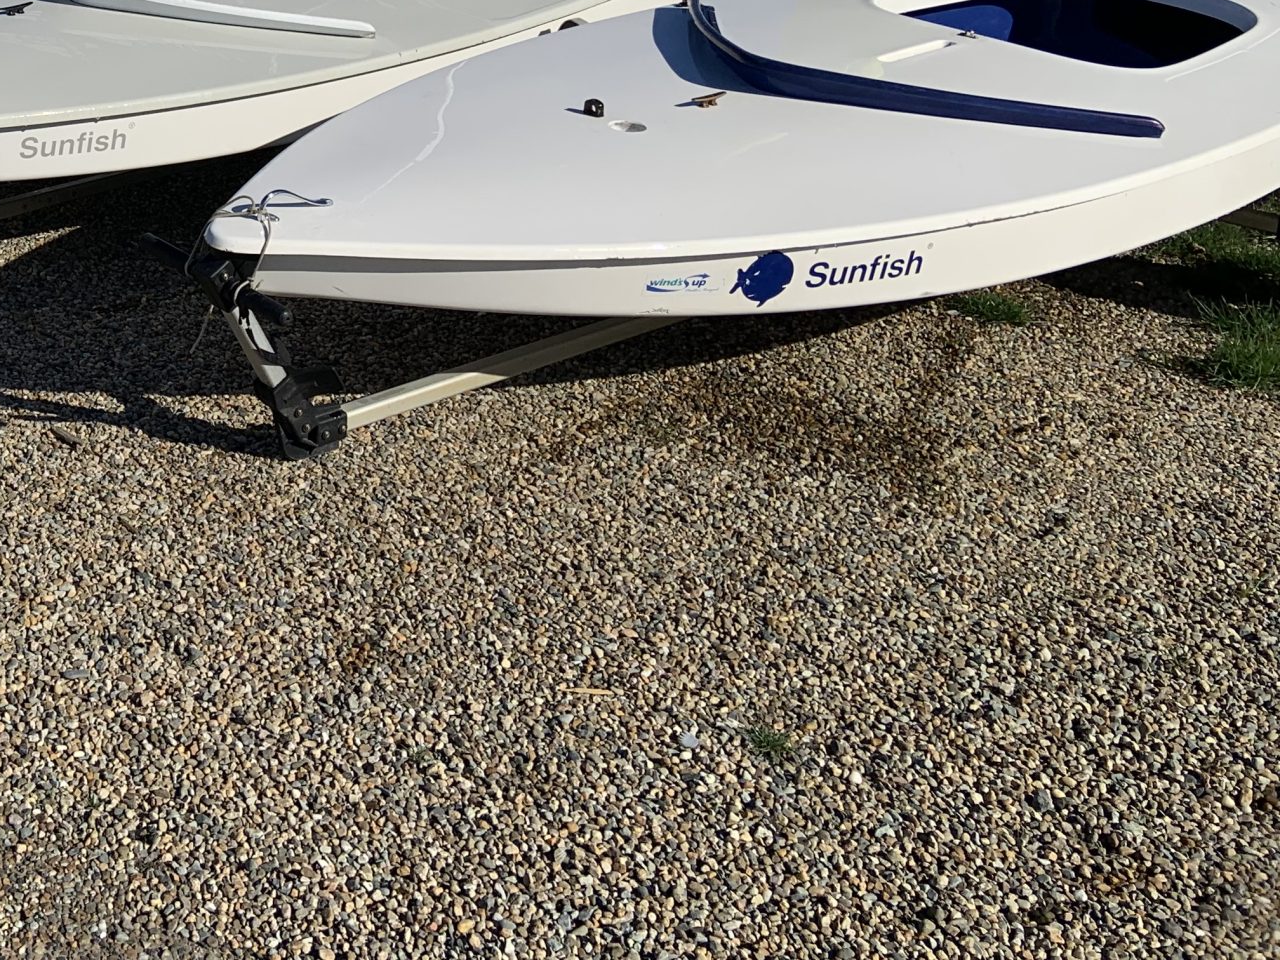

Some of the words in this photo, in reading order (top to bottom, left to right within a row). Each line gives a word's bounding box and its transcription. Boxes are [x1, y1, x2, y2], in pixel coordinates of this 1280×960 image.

[19, 128, 127, 159] Sunfish
[691, 279, 707, 288] up
[804, 250, 923, 288] Sunfish
